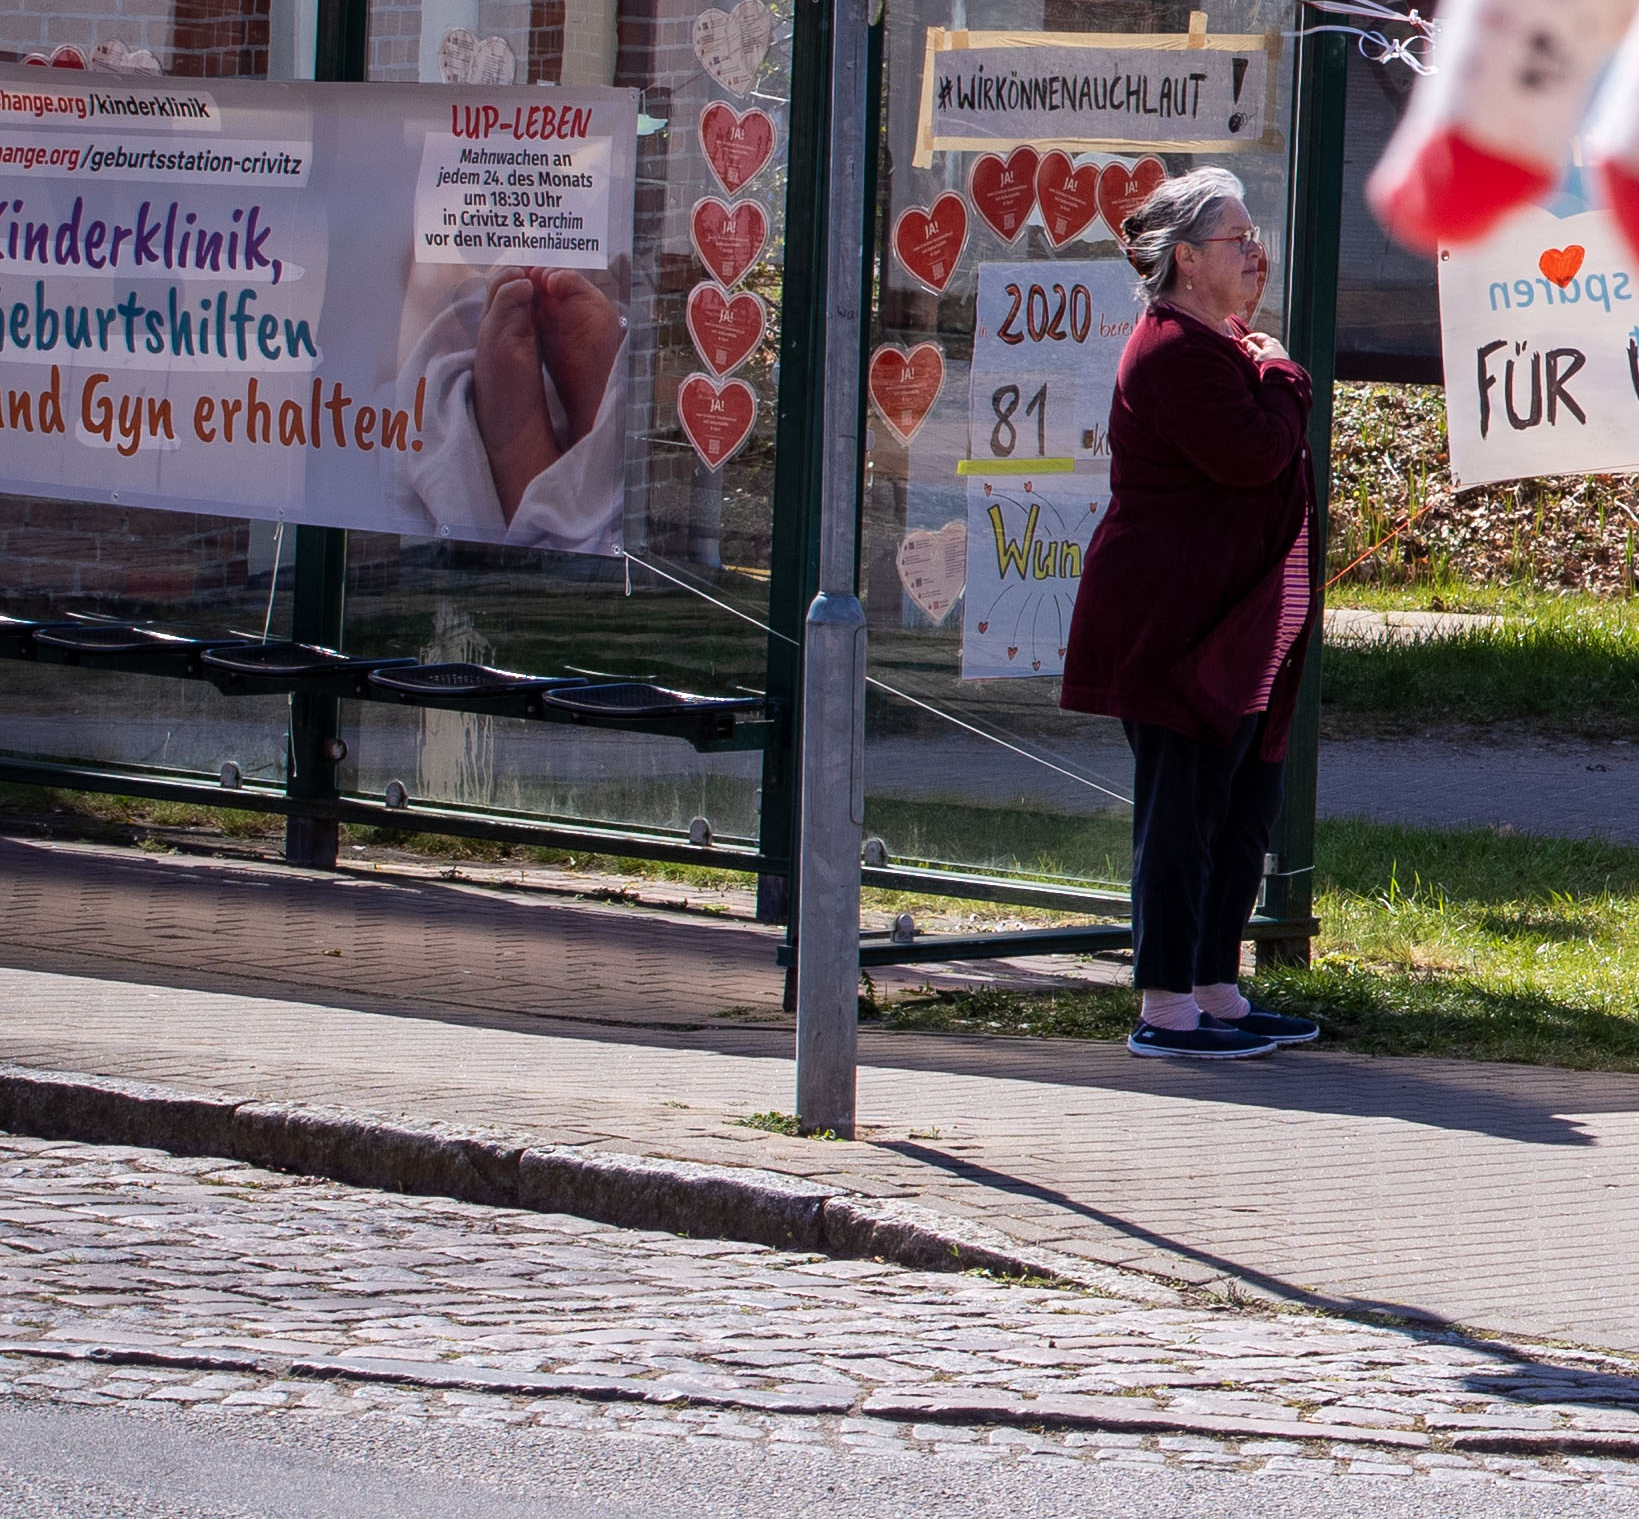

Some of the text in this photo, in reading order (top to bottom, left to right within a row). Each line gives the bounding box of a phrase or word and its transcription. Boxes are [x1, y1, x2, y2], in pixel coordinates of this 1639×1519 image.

[451, 104, 592, 140] LUP-LEBEN
[460, 148, 572, 166] Mahnwachen an
[436, 167, 593, 188] jedem 24. des Monats
[1000, 171, 1014, 187] JA!
[1063, 176, 1078, 192] JA!
[1124, 180, 1138, 196] JA!
[464, 191, 562, 207] um 18:30 Uhr
[443, 208, 583, 229] in Crivitz & Parchim
[722, 220, 736, 235] JA!
[924, 222, 939, 239] JA!
[425, 231, 599, 251] vor den Krankenhäusern
[718, 309, 734, 324] JA!
[997, 283, 1092, 345] 2020
[901, 367, 914, 383] JA!
[1477, 339, 1587, 440] FÜR
[0, 364, 428, 457] nd Gyn erhalten!
[710, 398, 725, 413] JA!
[990, 382, 1048, 457] 81
